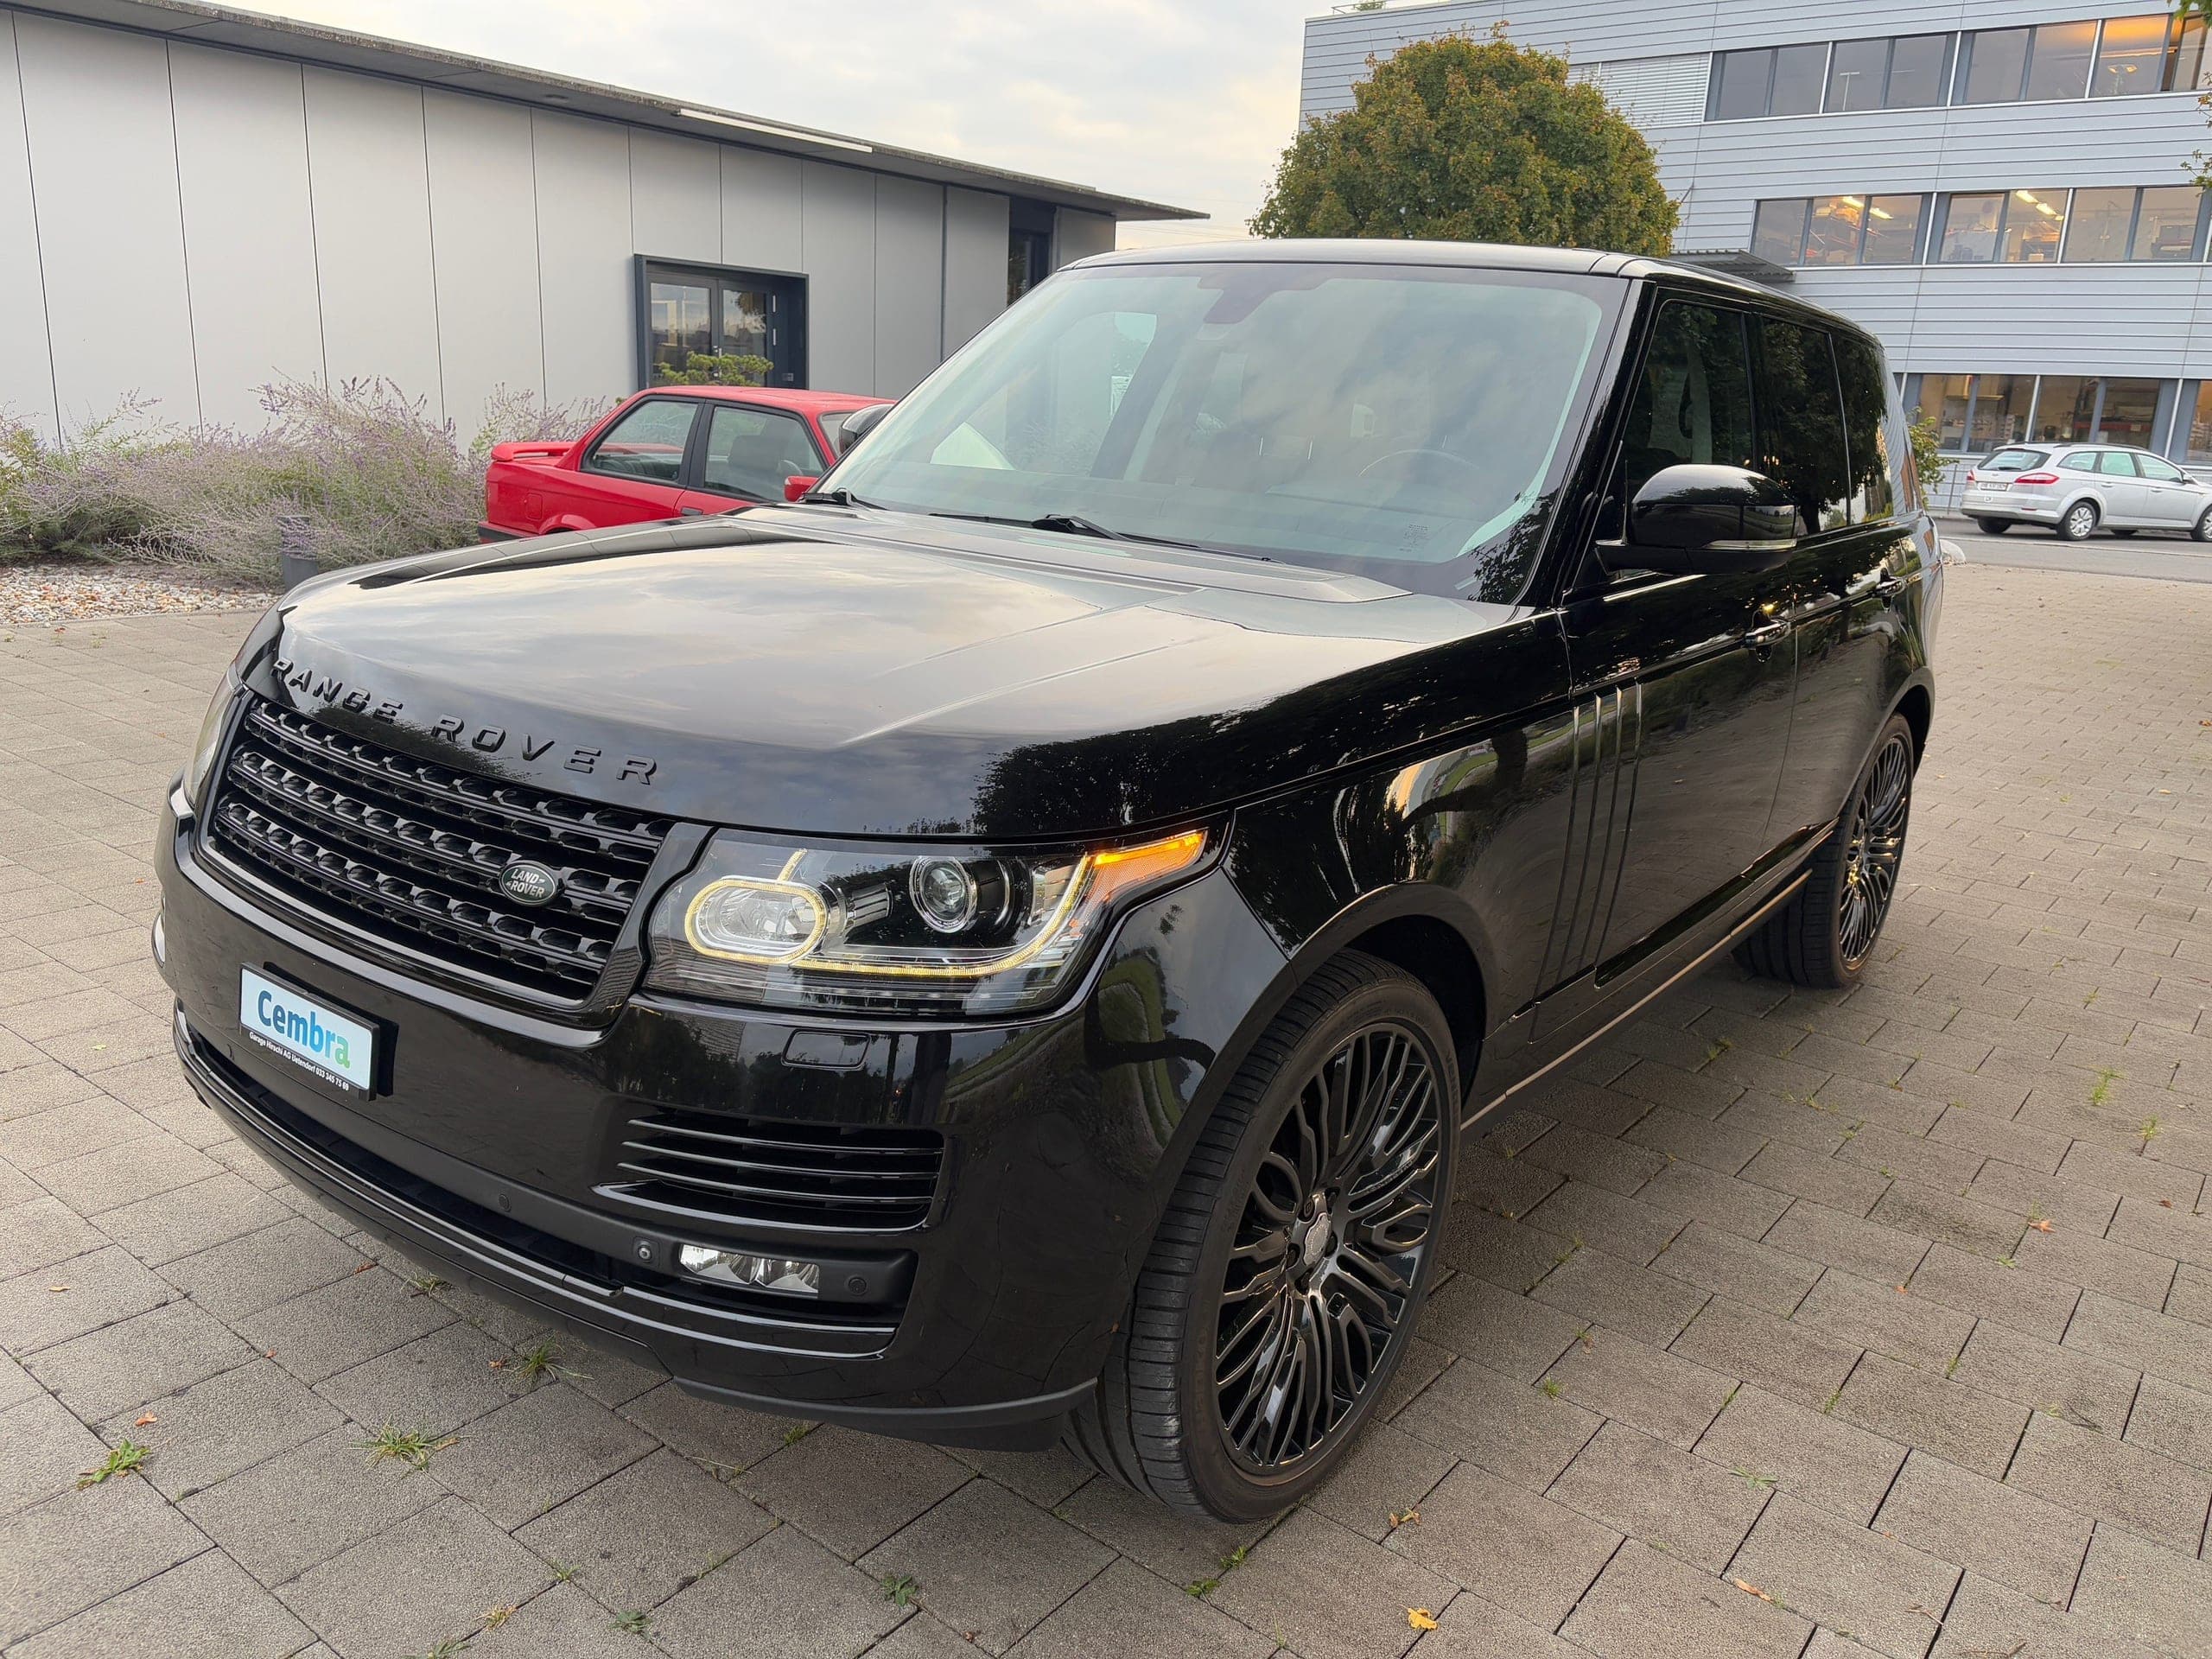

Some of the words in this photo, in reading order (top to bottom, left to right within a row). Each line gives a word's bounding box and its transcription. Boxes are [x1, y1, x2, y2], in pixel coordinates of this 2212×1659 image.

[271, 657, 404, 722] RANGE
[431, 713, 658, 785] ROVER
[511, 868, 539, 884] LAND
[511, 880, 545, 898] ROVER
[257, 990, 351, 1069] Cembra
[249, 1031, 266, 1046] Garage
[283, 1049, 292, 1059] AG
[291, 1053, 316, 1073] Uetendorf
[315, 1066, 326, 1078] 033
[325, 1071, 335, 1084] 345
[334, 1077, 342, 1087] 75
